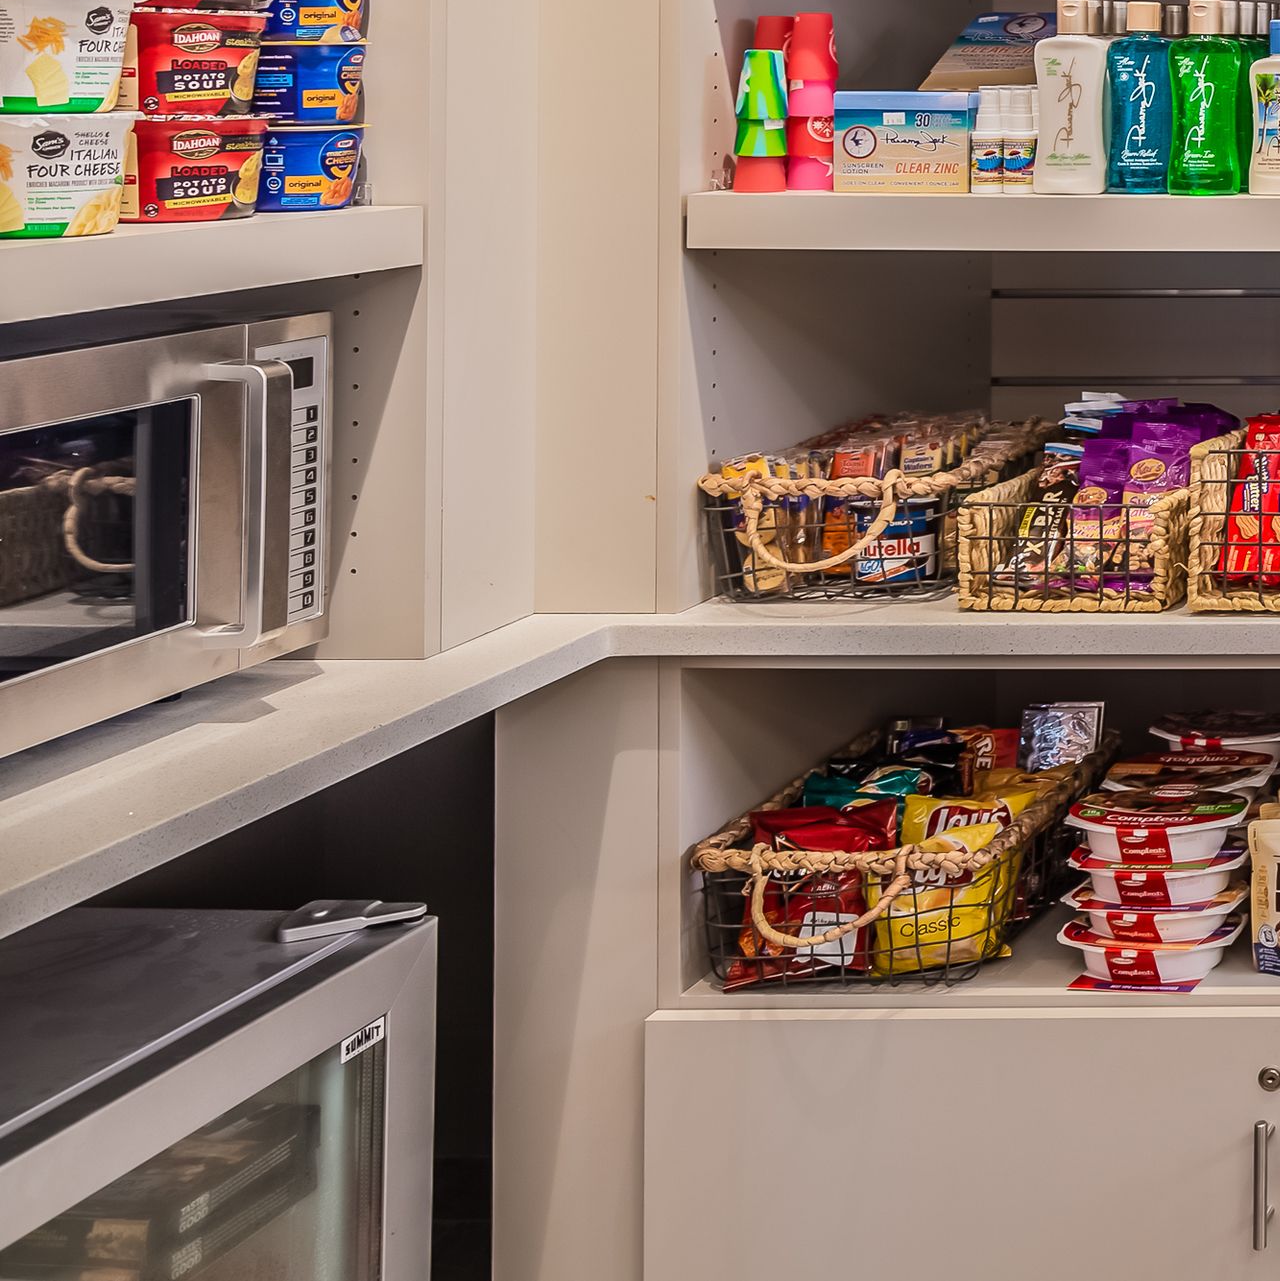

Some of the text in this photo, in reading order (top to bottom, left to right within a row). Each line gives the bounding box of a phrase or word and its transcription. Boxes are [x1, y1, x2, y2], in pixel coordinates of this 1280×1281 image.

[304, 10, 336, 21] original
[174, 32, 220, 45] IDAHOAN
[173, 60, 227, 71] LOADED
[174, 73, 226, 81] POTATO
[174, 80, 226, 91] SOUP
[915, 113, 930, 128] 30
[70, 149, 118, 161] ITALIAN
[27, 162, 121, 178] FOUR CHEESE
[896, 162, 960, 174] CLEAR ZINC
[288, 179, 322, 189] original
[904, 462, 932, 470] Wafers
[1106, 814, 1194, 823] Compleats
[1123, 847, 1166, 855] Compleats
[900, 915, 961, 938] Classic
[344, 1024, 382, 1056] SUMMIT
